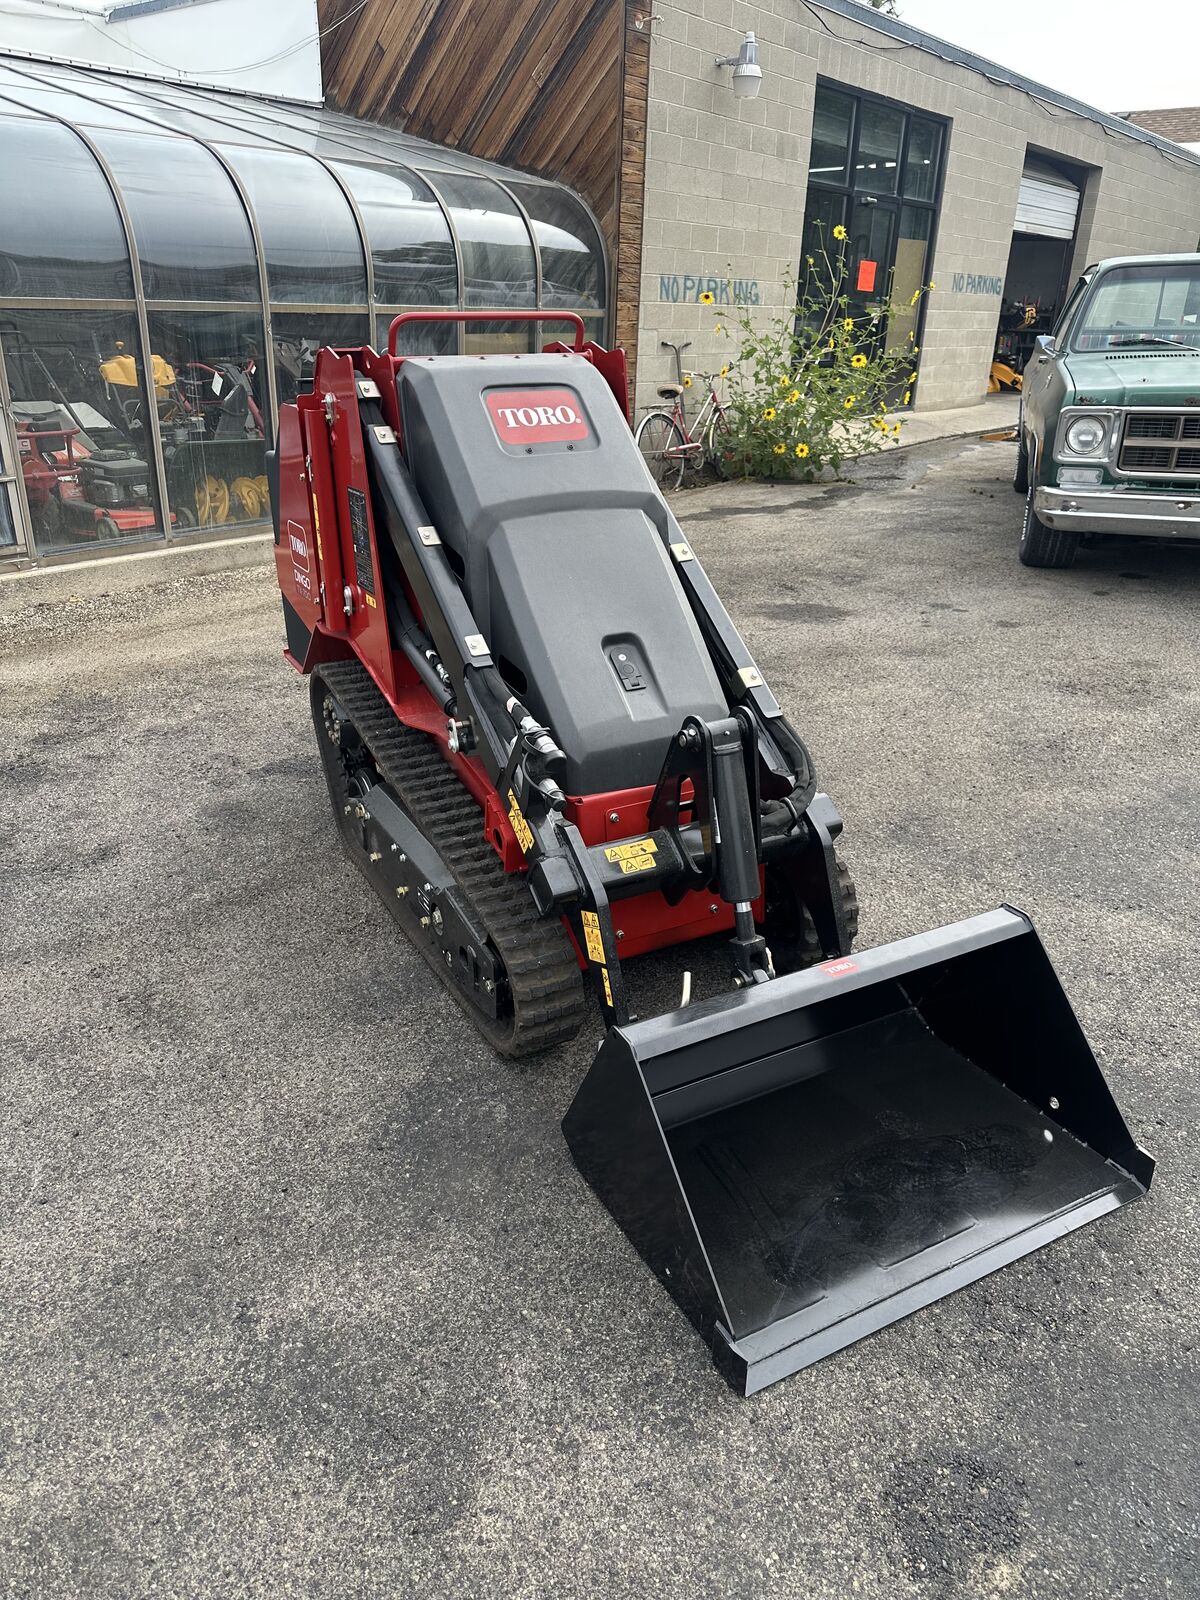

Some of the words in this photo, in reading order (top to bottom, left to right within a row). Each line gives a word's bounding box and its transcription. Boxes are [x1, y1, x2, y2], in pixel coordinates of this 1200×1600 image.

[660, 275, 679, 303] NO
[683, 275, 760, 305] PARKING
[952, 273, 964, 293] NO
[965, 274, 1001, 296] PARKING
[497, 405, 577, 428] TORO
[290, 534, 306, 557] TORO
[294, 569, 311, 589] DINGO
